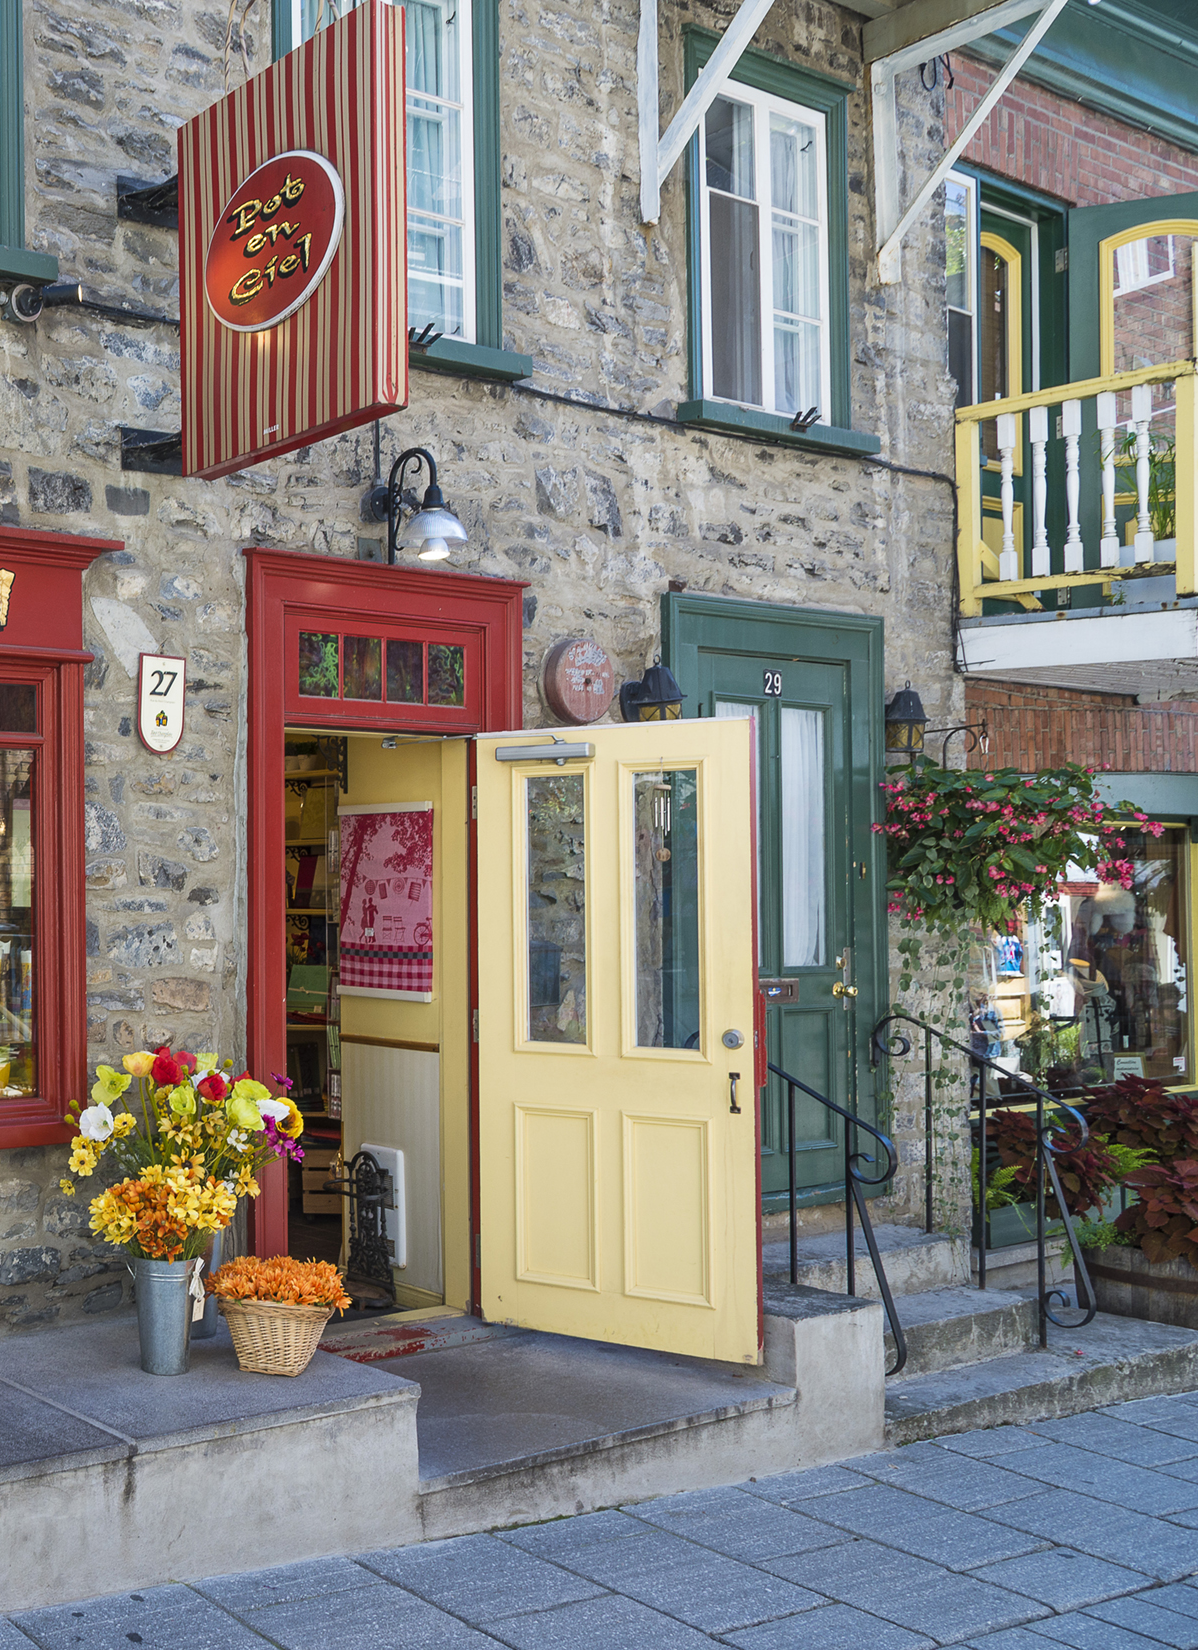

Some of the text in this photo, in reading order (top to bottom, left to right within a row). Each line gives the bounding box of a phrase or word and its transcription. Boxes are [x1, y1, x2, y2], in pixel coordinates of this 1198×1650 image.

[229, 172, 306, 239] Pot
[244, 220, 301, 256] en
[229, 232, 313, 305] Ciel
[149, 670, 178, 697] 27
[764, 672, 782, 695] 29
